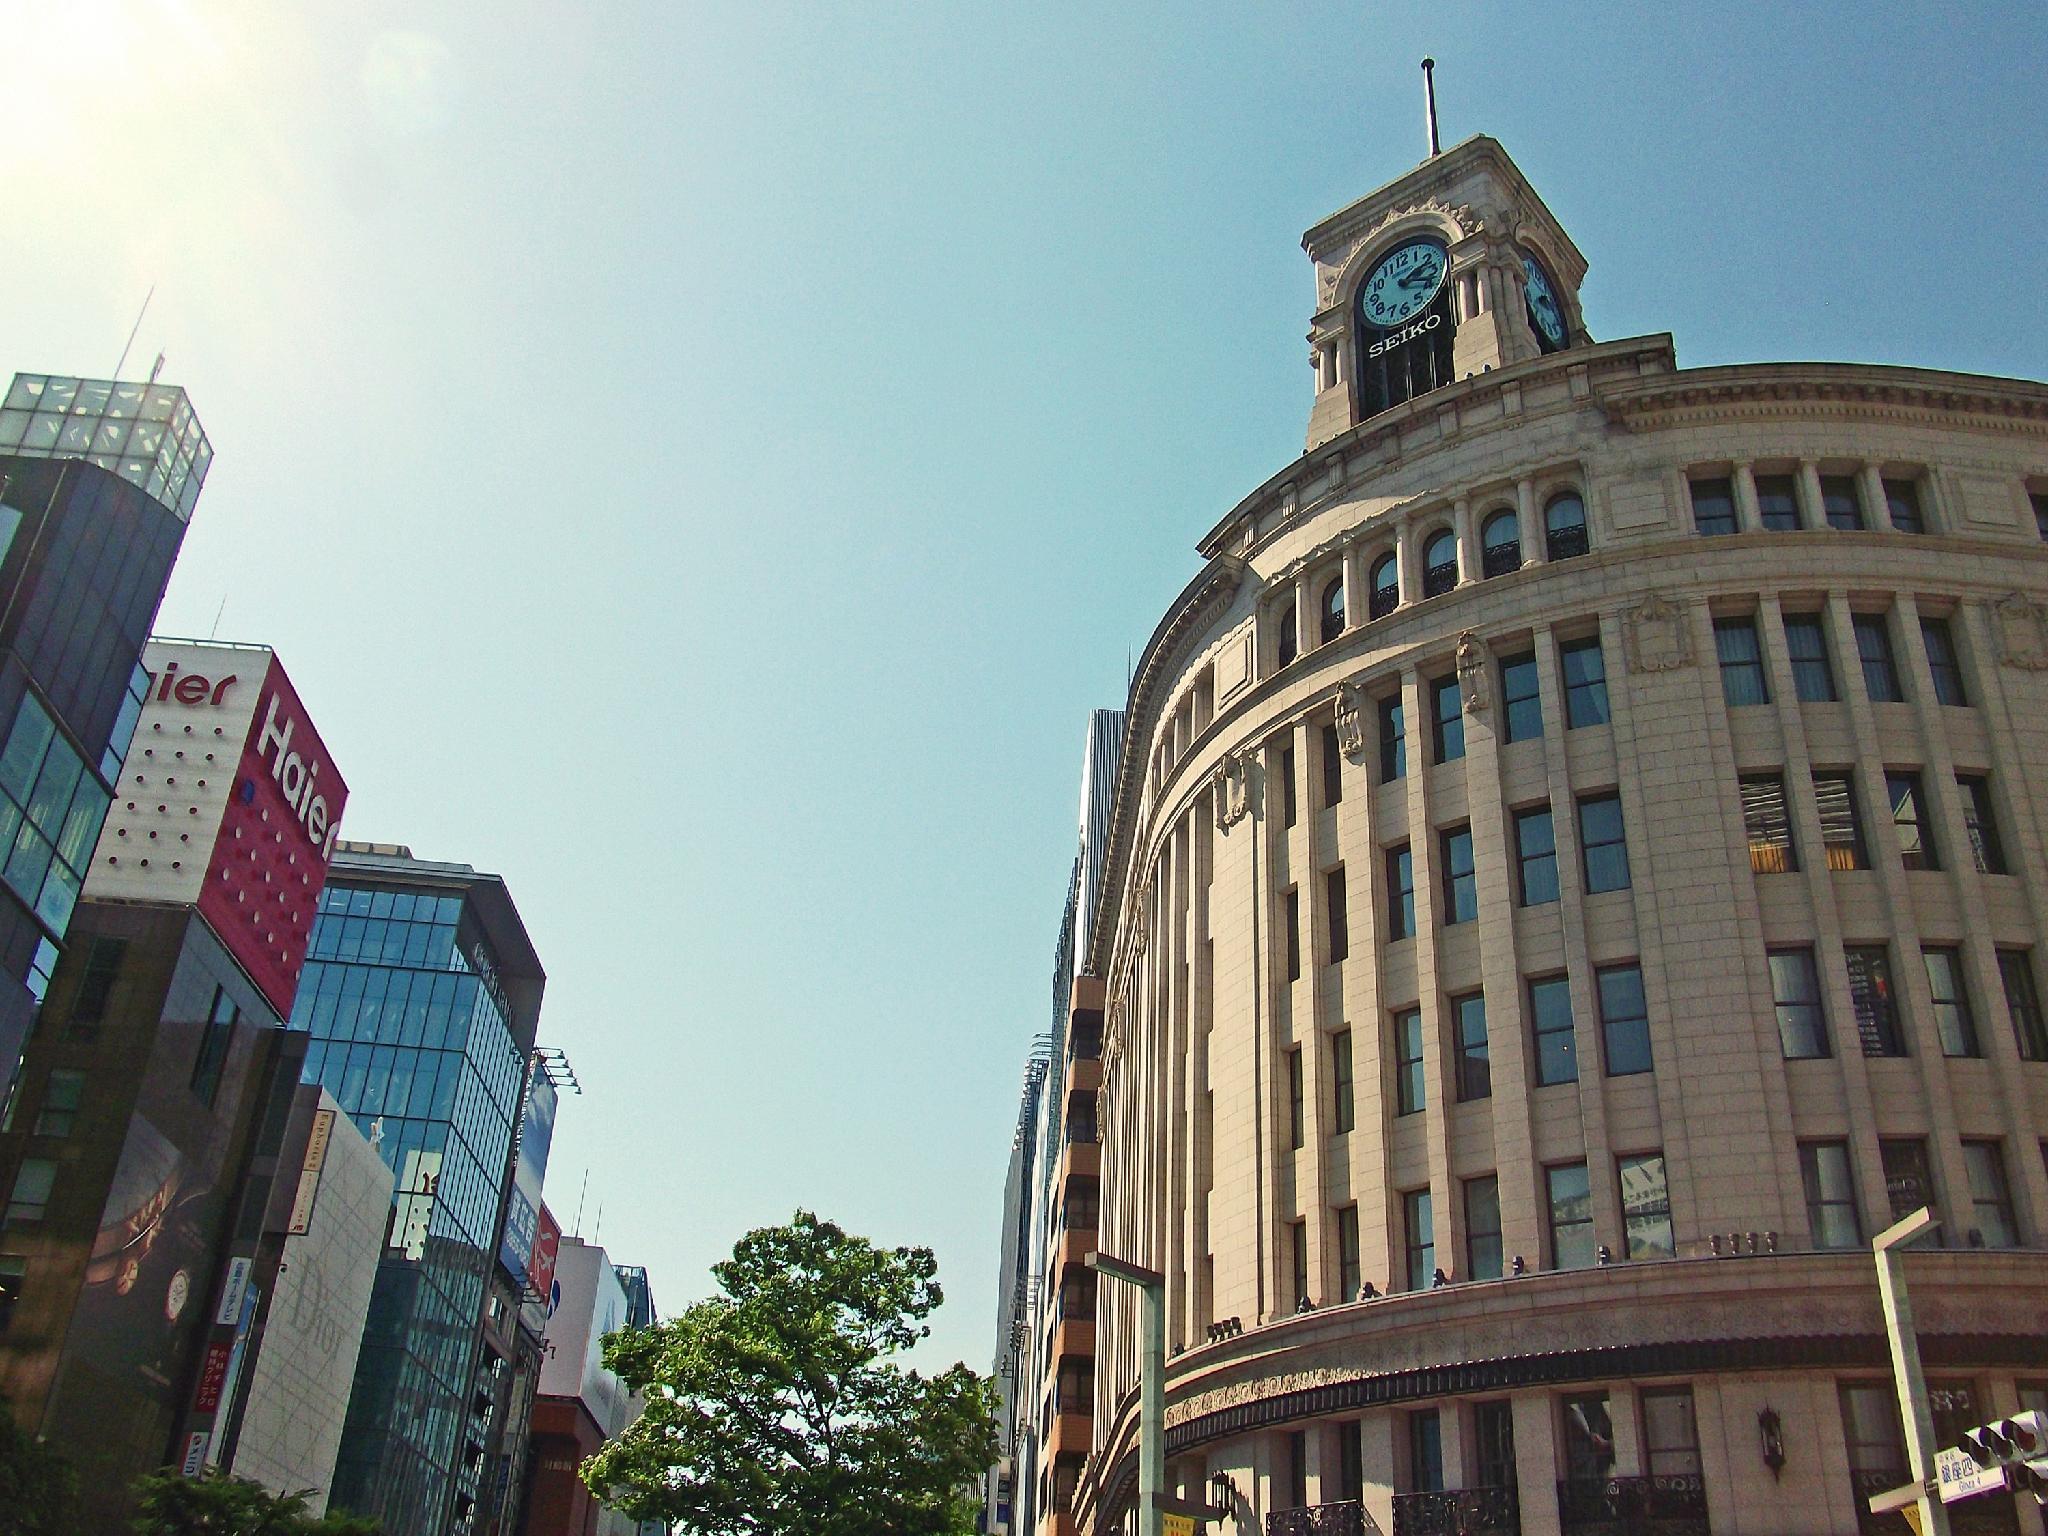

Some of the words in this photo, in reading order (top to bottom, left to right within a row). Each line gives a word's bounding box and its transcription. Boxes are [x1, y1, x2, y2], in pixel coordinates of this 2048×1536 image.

[1395, 253, 1408, 268] 12
[1383, 263, 1393, 278] 11
[1373, 279, 1384, 292] 10
[1369, 294, 1379, 306] 9
[1413, 292, 1423, 306] 5
[1376, 302, 1385, 315] 8
[1387, 304, 1397, 317] 7
[1400, 302, 1410, 315] 6
[1369, 314, 1441, 358] SEIKO
[145, 662, 237, 706] ier
[257, 691, 340, 862] Haier
